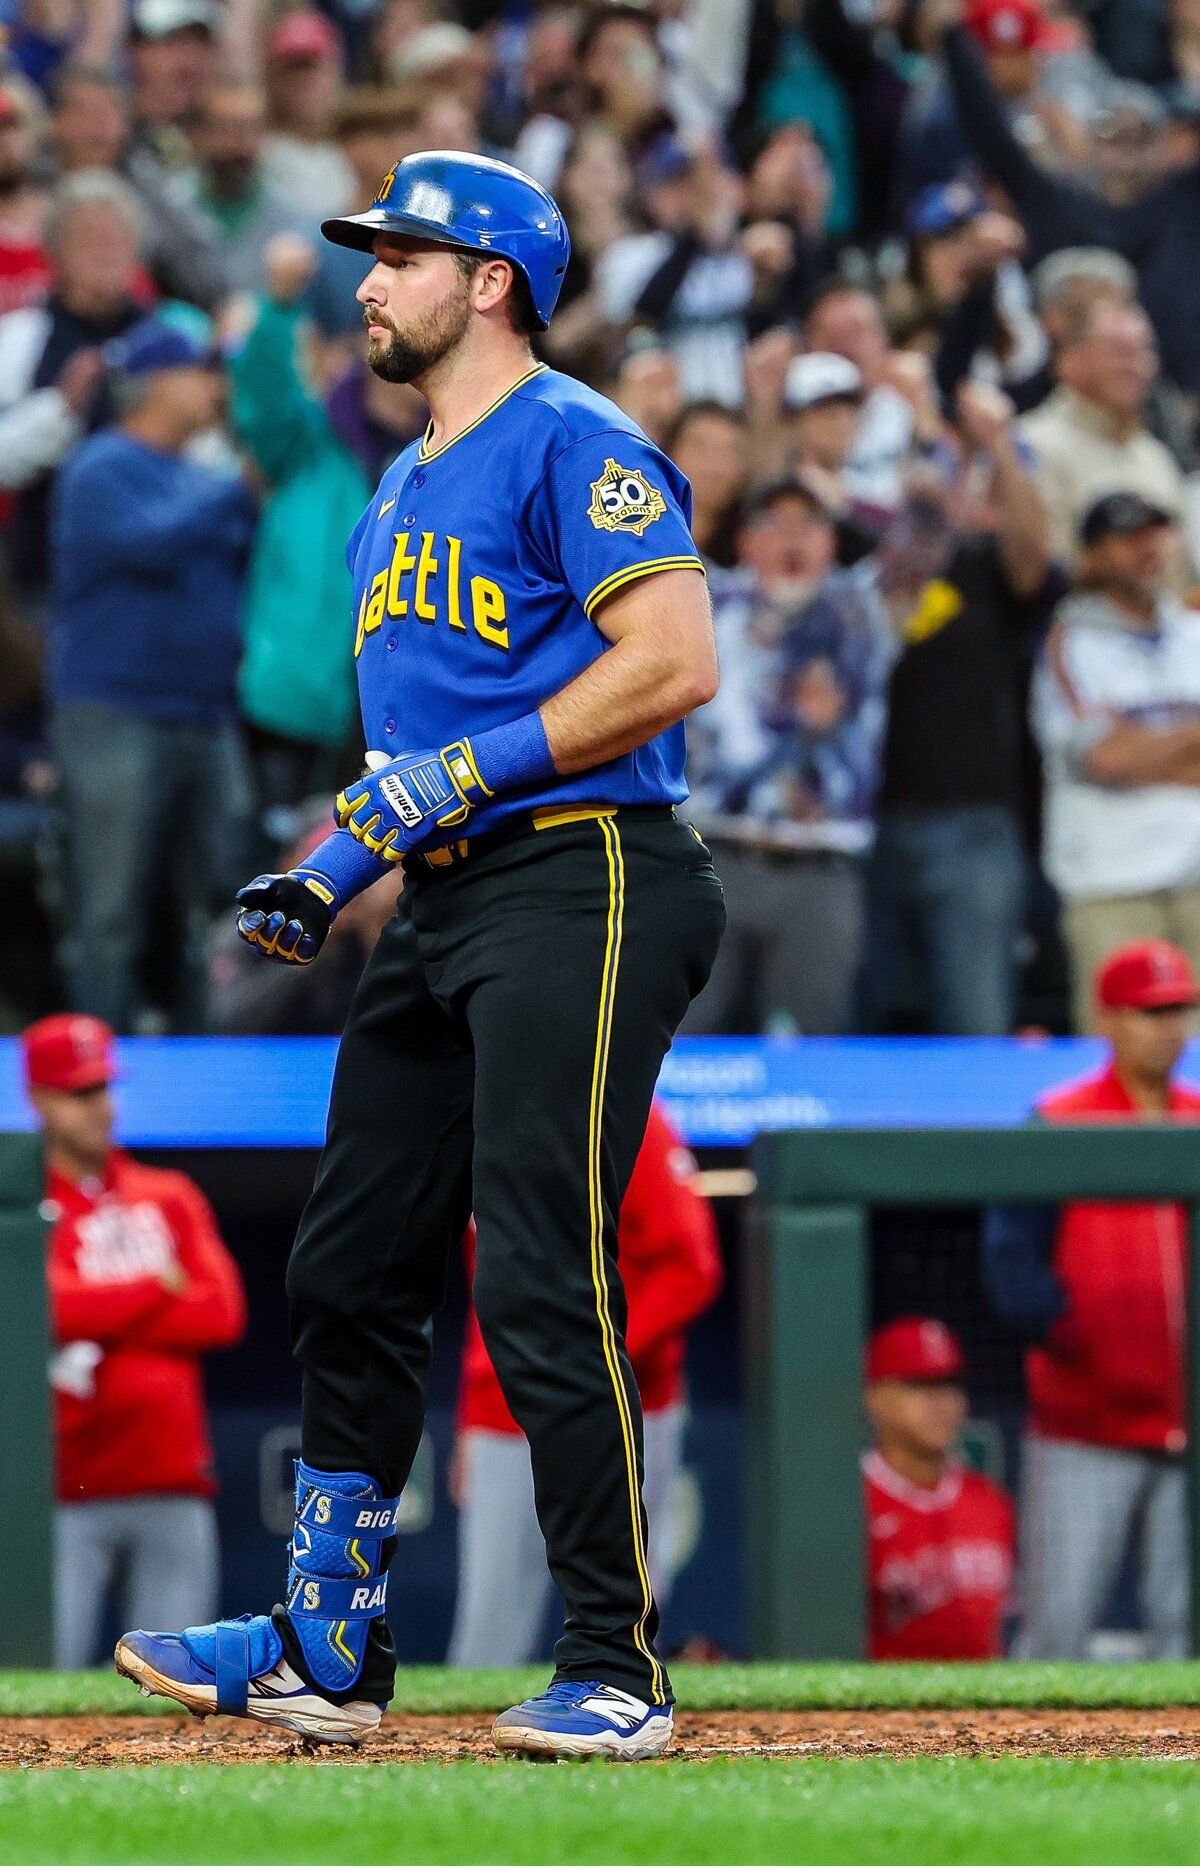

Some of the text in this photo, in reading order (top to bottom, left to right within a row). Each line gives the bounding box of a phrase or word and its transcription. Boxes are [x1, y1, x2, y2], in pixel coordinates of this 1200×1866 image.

[600, 477, 647, 513] 50
[610, 506, 652, 523] seasons
[355, 1509, 391, 1529] BIG
